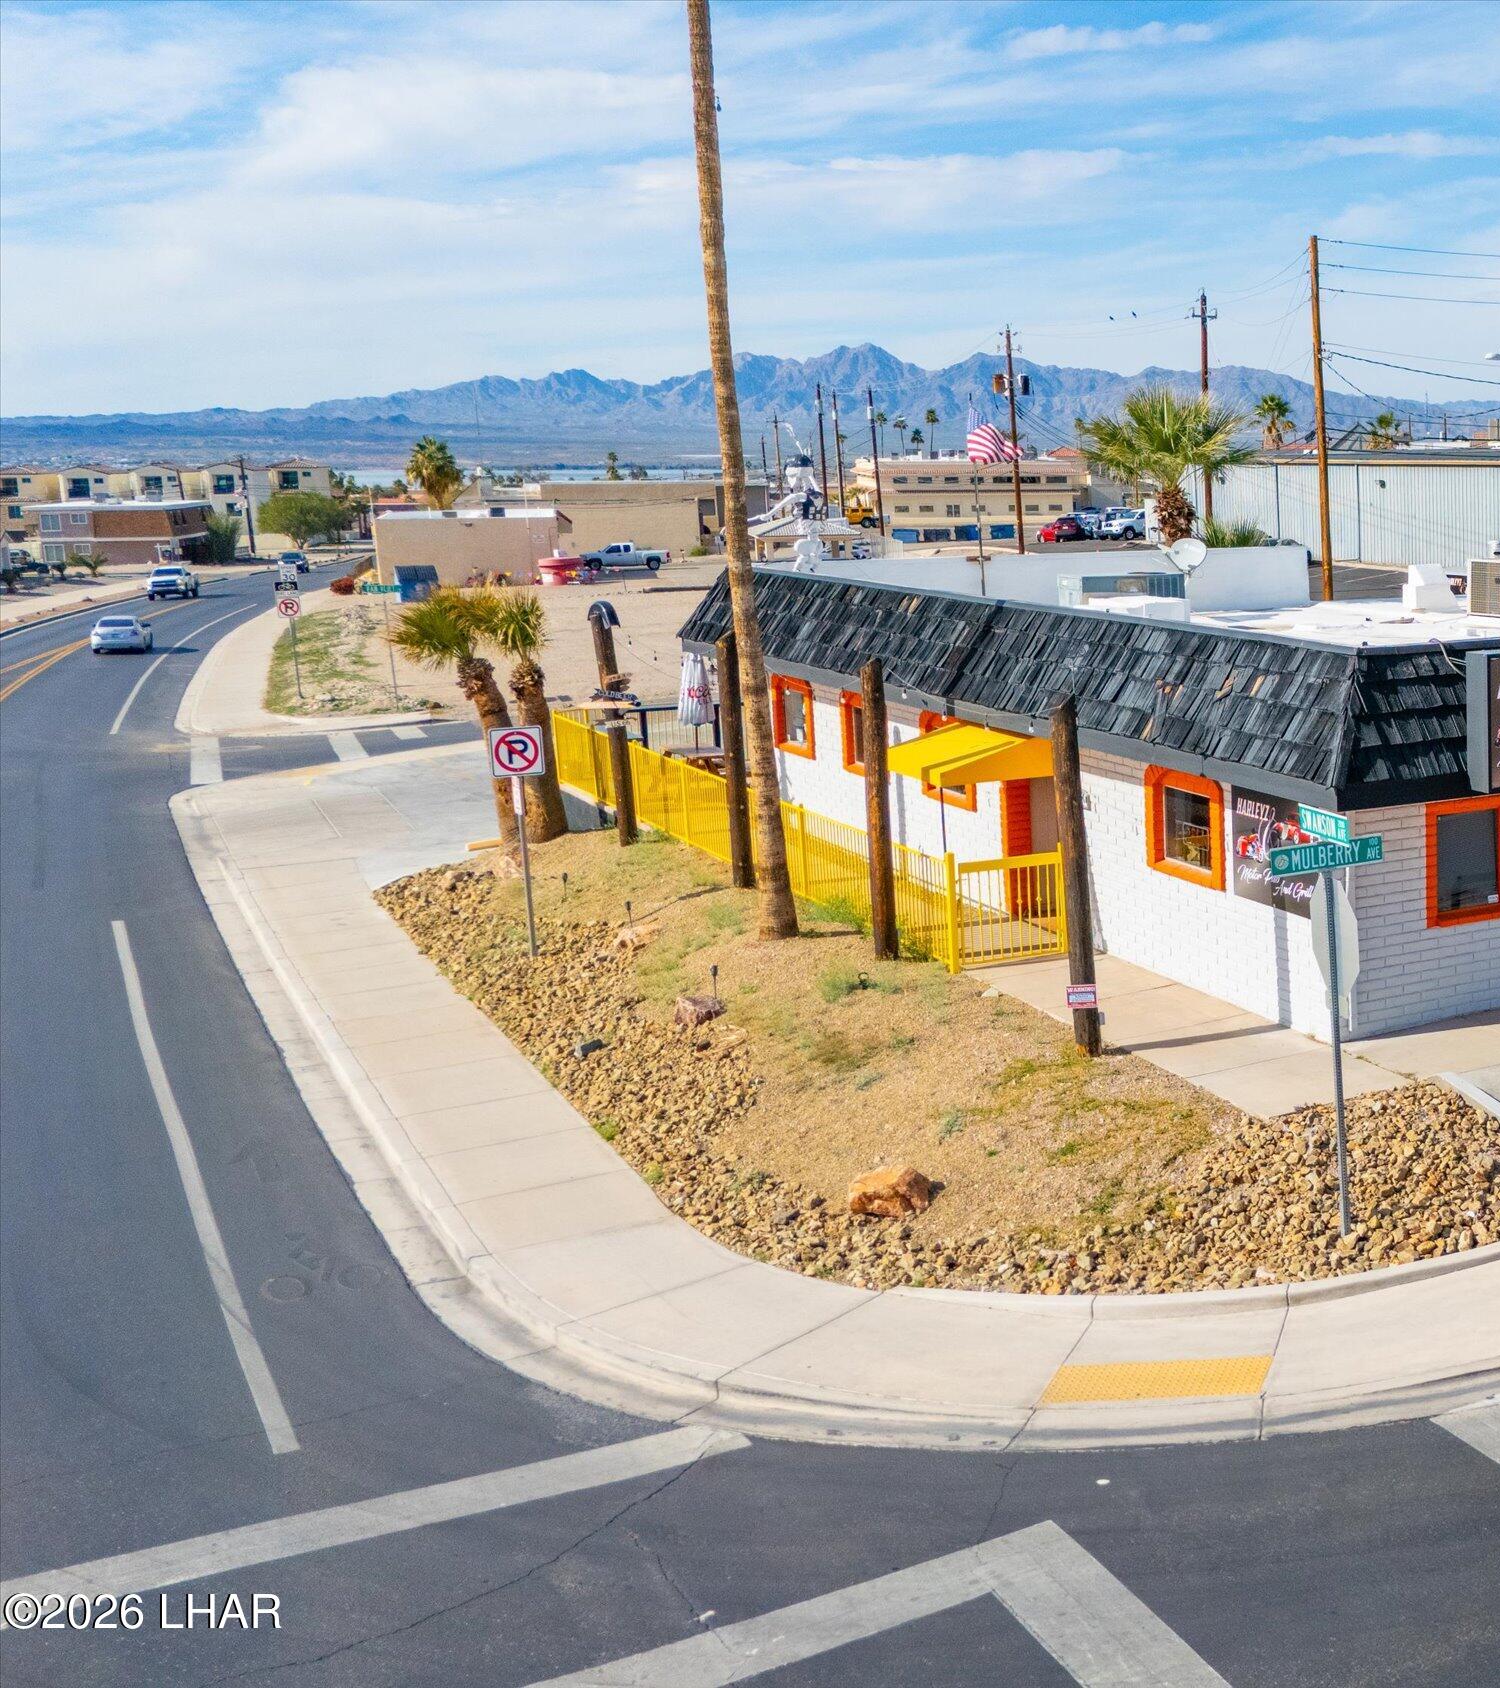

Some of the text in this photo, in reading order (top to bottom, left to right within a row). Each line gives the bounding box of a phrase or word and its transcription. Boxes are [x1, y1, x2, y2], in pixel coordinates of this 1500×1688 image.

[282, 573, 296, 581] 30
[1236, 797, 1270, 822] HARLEYZ
[1301, 808, 1337, 839] SWANSON
[1337, 828, 1347, 842] AVE
[1291, 840, 1360, 872] MULBERRY
[1366, 846, 1381, 860] AVE
[1237, 864, 1263, 884] Motor
[1273, 880, 1295, 897] And
[1292, 882, 1315, 903] Grill
